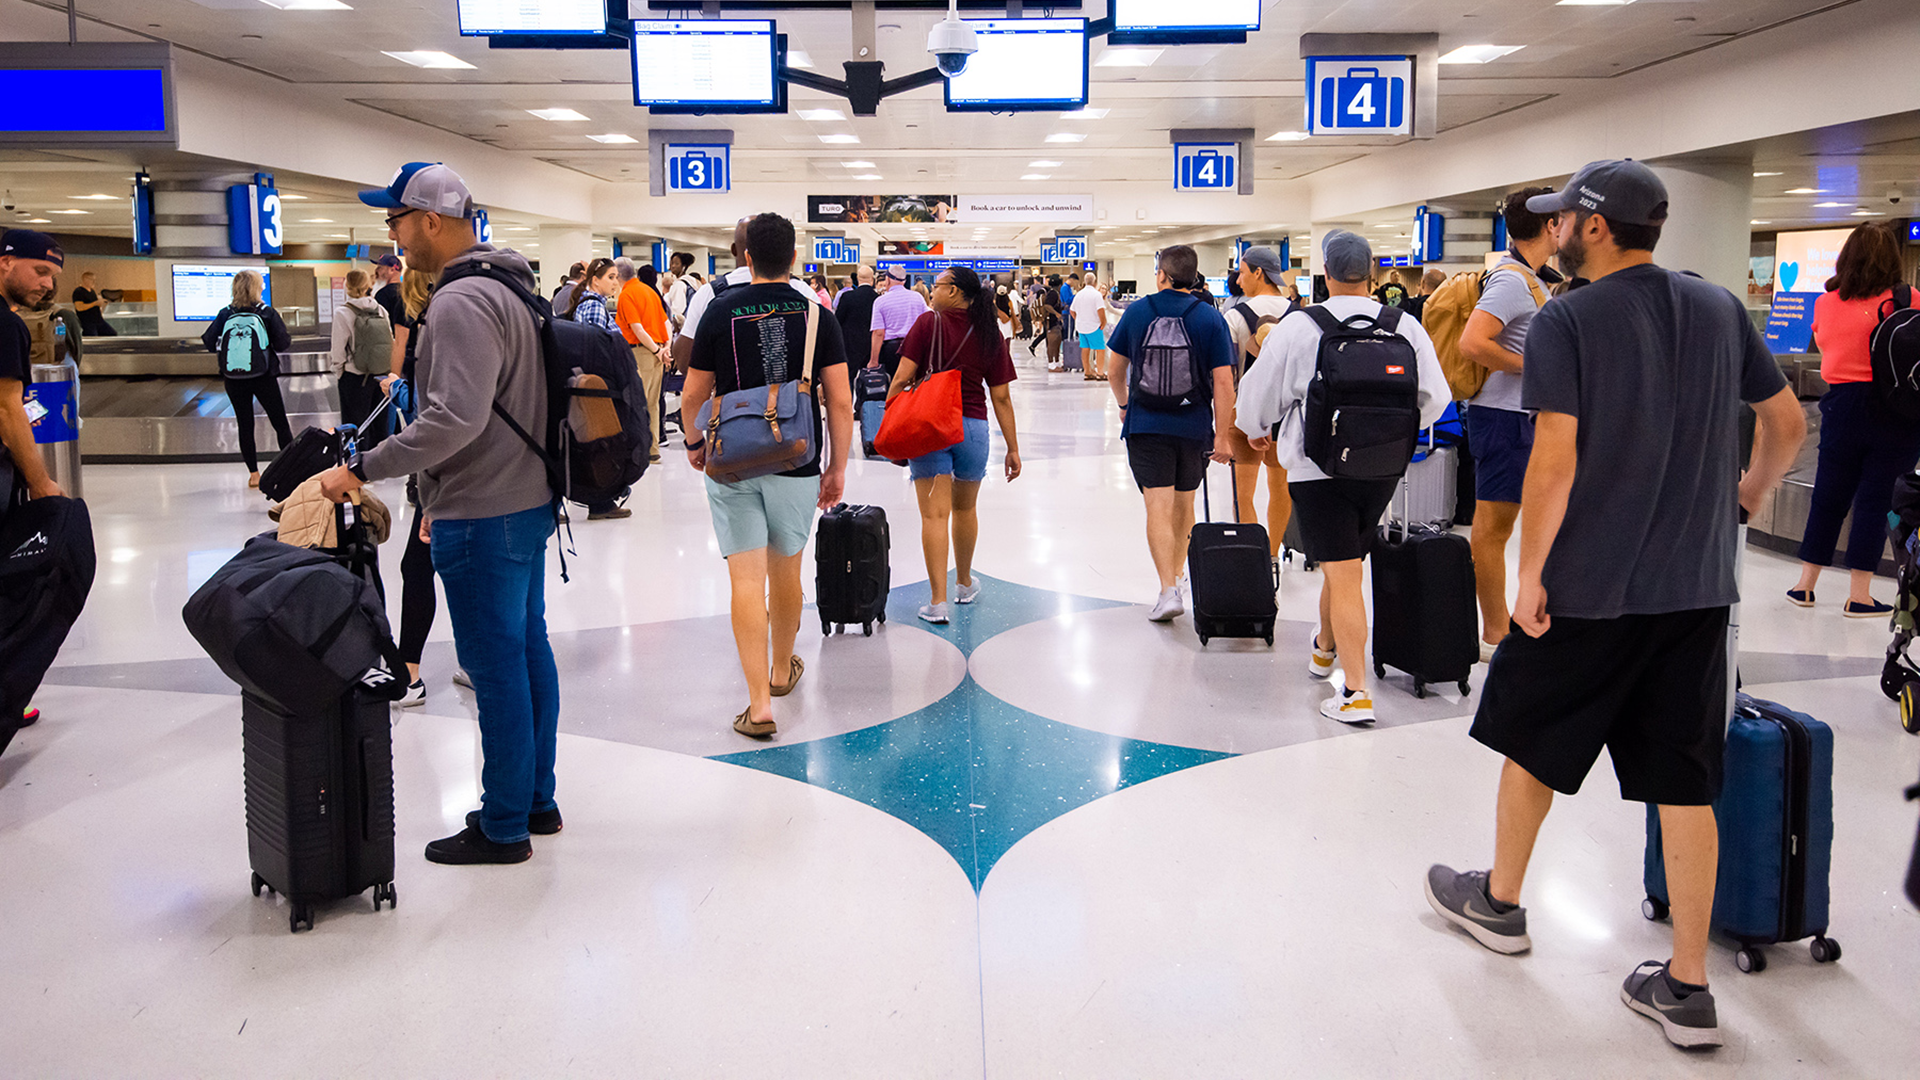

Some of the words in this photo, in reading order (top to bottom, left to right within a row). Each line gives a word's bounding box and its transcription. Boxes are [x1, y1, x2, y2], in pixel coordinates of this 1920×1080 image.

[1347, 82, 1376, 122] 4
[687, 160, 705, 186] 3
[1198, 159, 1217, 184] 4
[1579, 185, 1605, 202] Arizona
[1579, 196, 1597, 210] 2023
[263, 194, 283, 248] 3
[824, 245, 832, 258] 1
[844, 251, 849, 261] 1
[1068, 244, 1077, 257] 2
[1807, 248, 1820, 261] We
[1822, 248, 1838, 261] love
